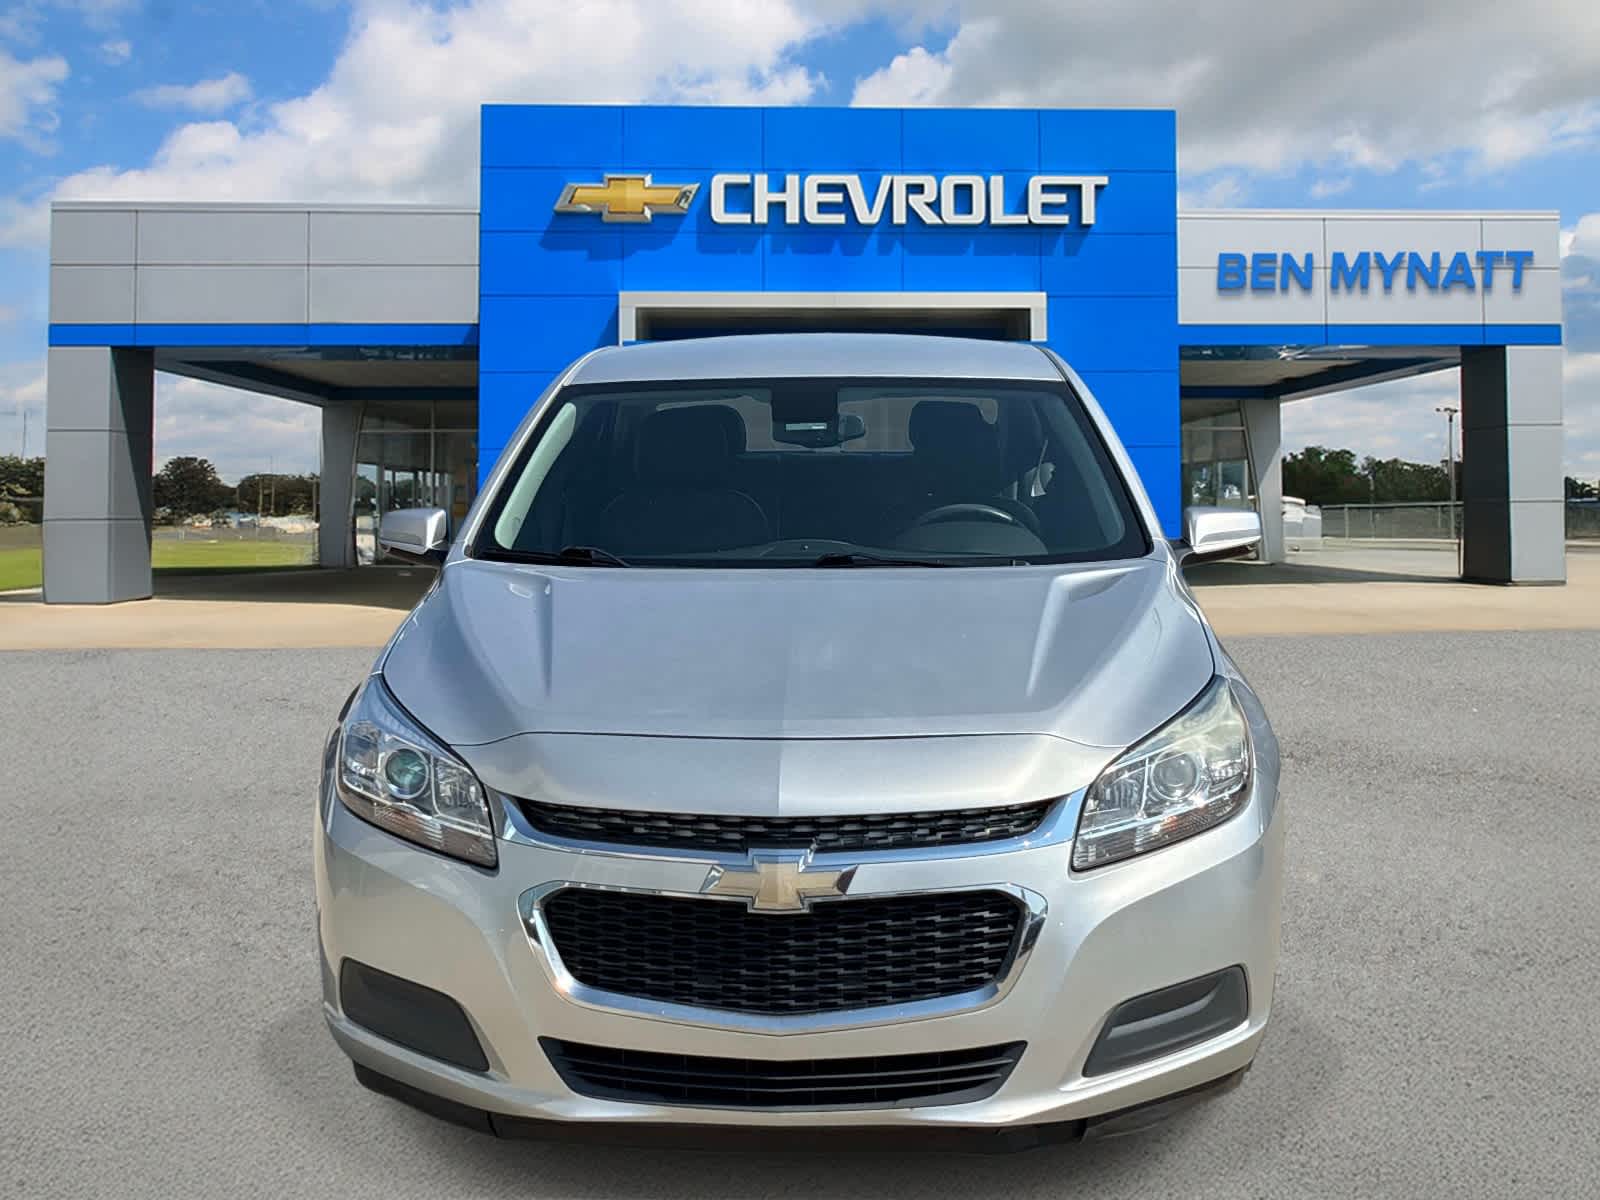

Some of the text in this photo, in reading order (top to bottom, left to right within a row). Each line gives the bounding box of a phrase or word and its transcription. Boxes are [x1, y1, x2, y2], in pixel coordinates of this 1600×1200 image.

[710, 173, 1109, 226] CHEVROLET
[1217, 251, 1534, 290] BEN MYNATT
